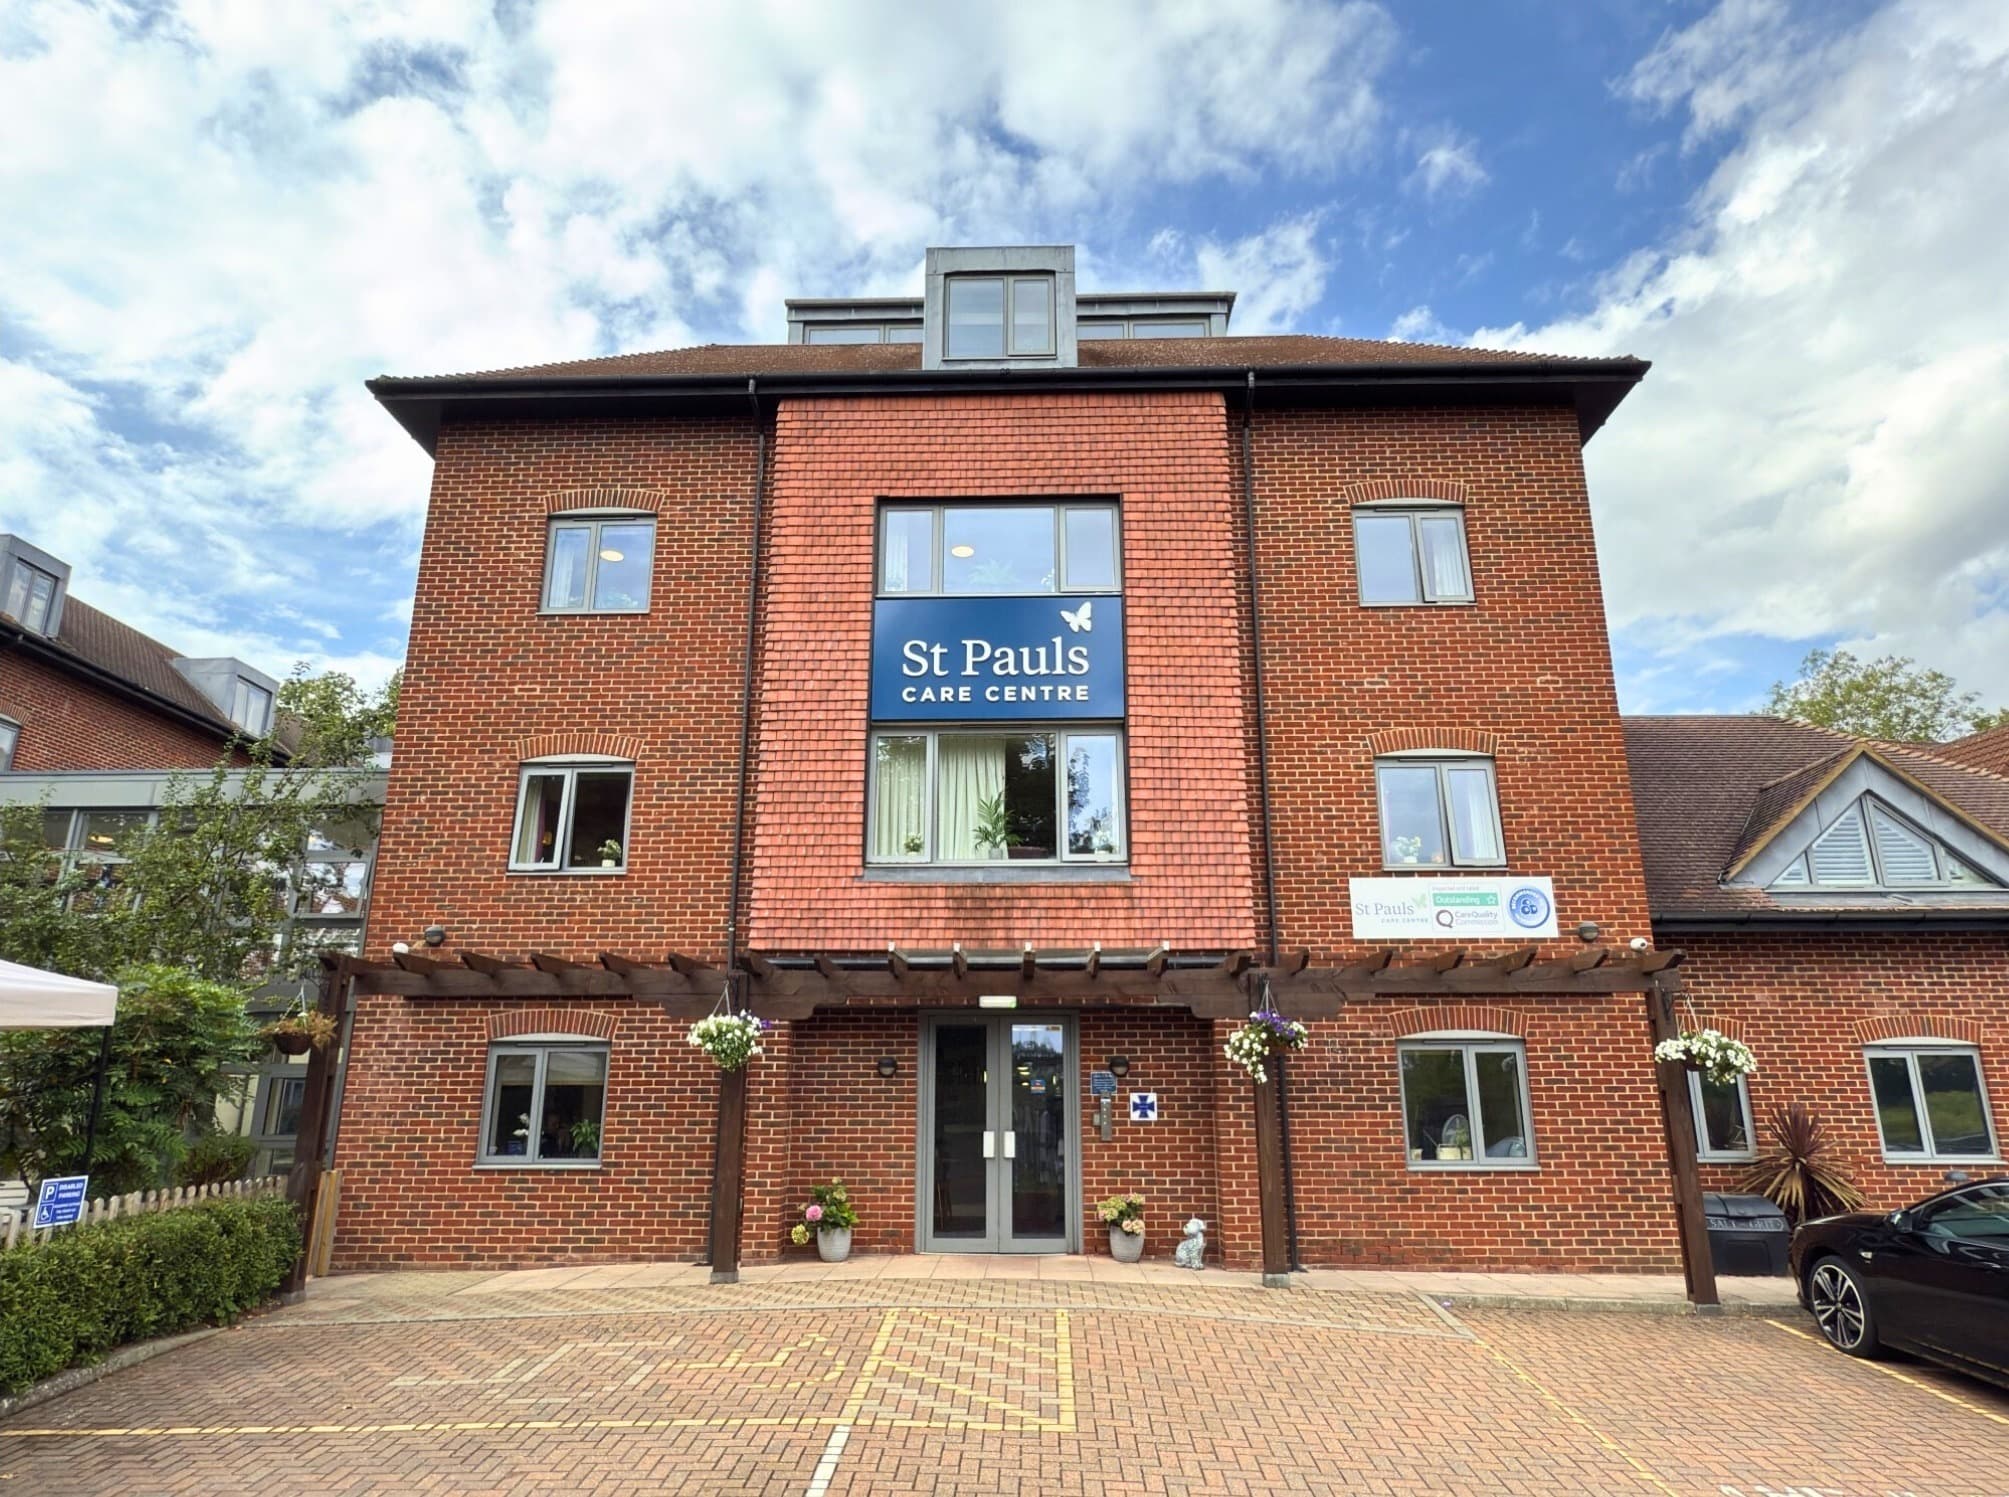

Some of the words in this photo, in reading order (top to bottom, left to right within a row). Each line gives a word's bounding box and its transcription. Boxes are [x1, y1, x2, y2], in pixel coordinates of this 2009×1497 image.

[901, 640, 949, 677] St
[961, 636, 1090, 677] Pauls
[902, 686, 972, 703] CARE
[985, 685, 1090, 702] CENTRE
[1435, 896, 1481, 905] Outstanding
[1355, 903, 1370, 915] St
[1374, 902, 1415, 915] Pauls
[45, 1186, 55, 1200] P
